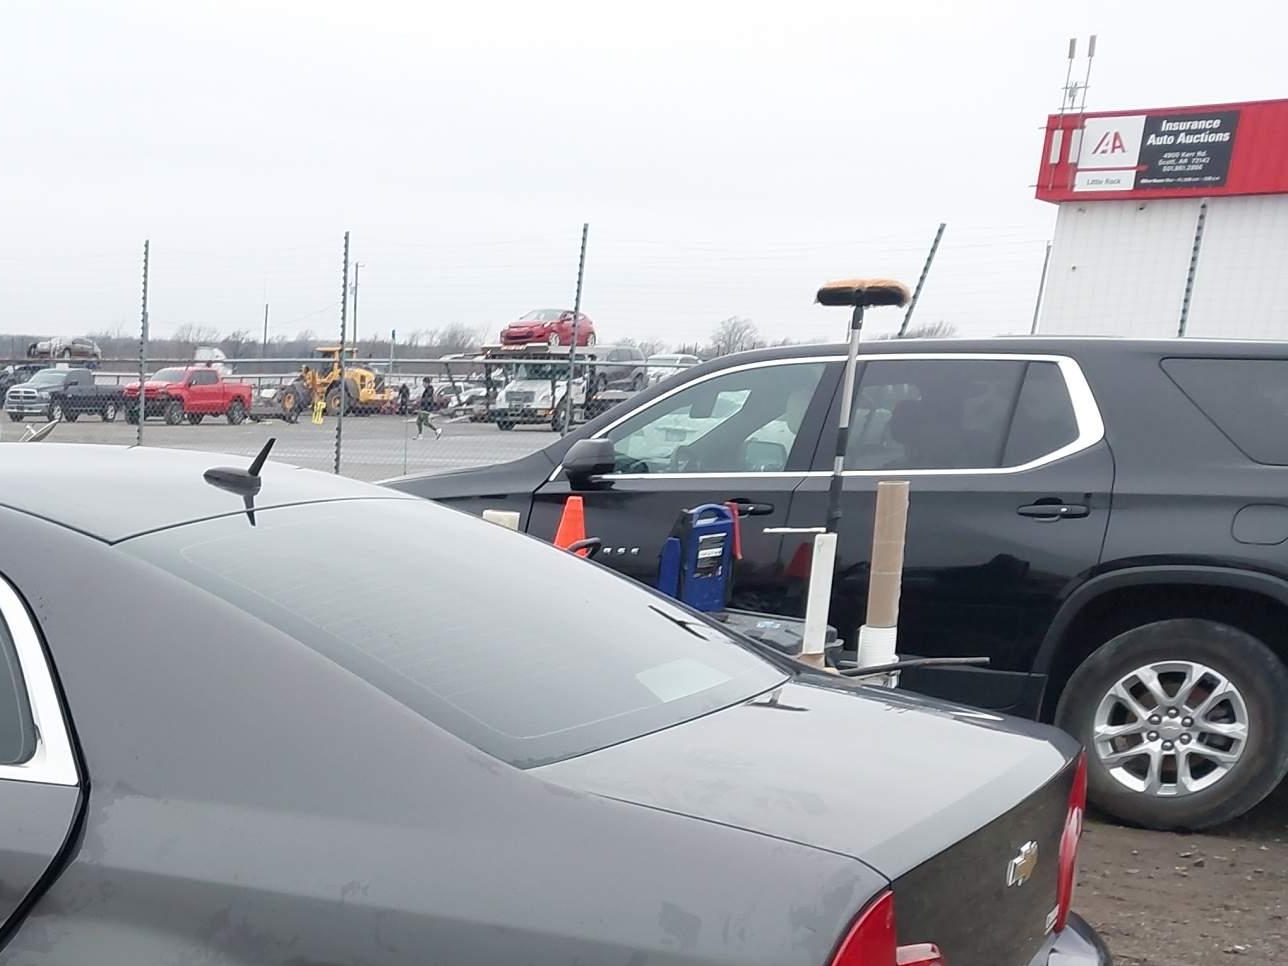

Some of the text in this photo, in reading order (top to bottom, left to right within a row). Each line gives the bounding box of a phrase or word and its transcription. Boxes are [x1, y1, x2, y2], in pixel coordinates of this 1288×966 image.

[1161, 118, 1221, 132] Insurance
[1146, 130, 1231, 146] Auto Auctions
